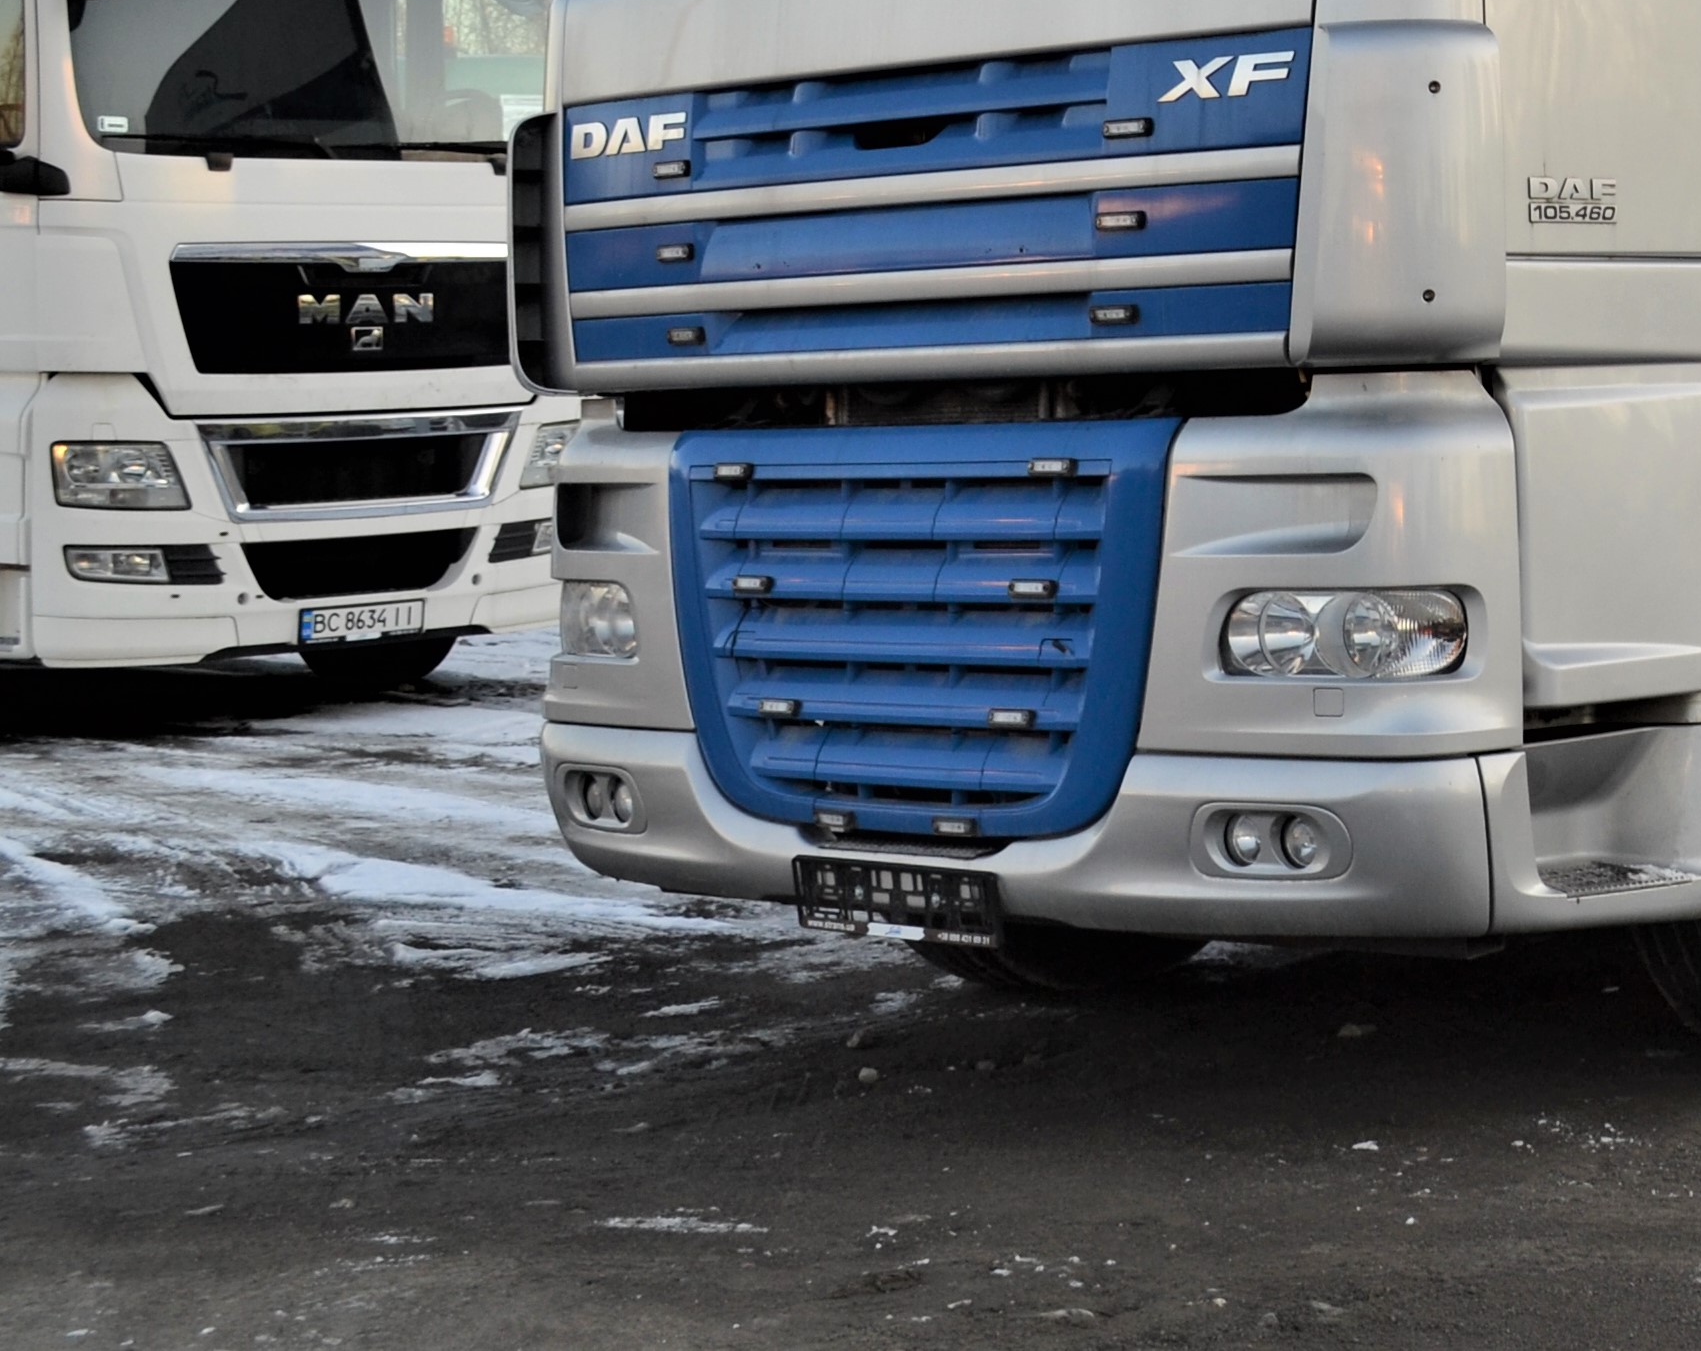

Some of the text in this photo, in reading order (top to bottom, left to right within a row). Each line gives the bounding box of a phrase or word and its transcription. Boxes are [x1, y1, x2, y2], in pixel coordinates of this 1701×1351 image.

[1156, 50, 1296, 104] XF
[569, 111, 687, 161] DAF
[1527, 176, 1617, 201] DAF
[1533, 204, 1617, 222] 105.460
[298, 292, 434, 325] MAN
[313, 612, 340, 634] BC
[345, 608, 387, 631] 8634
